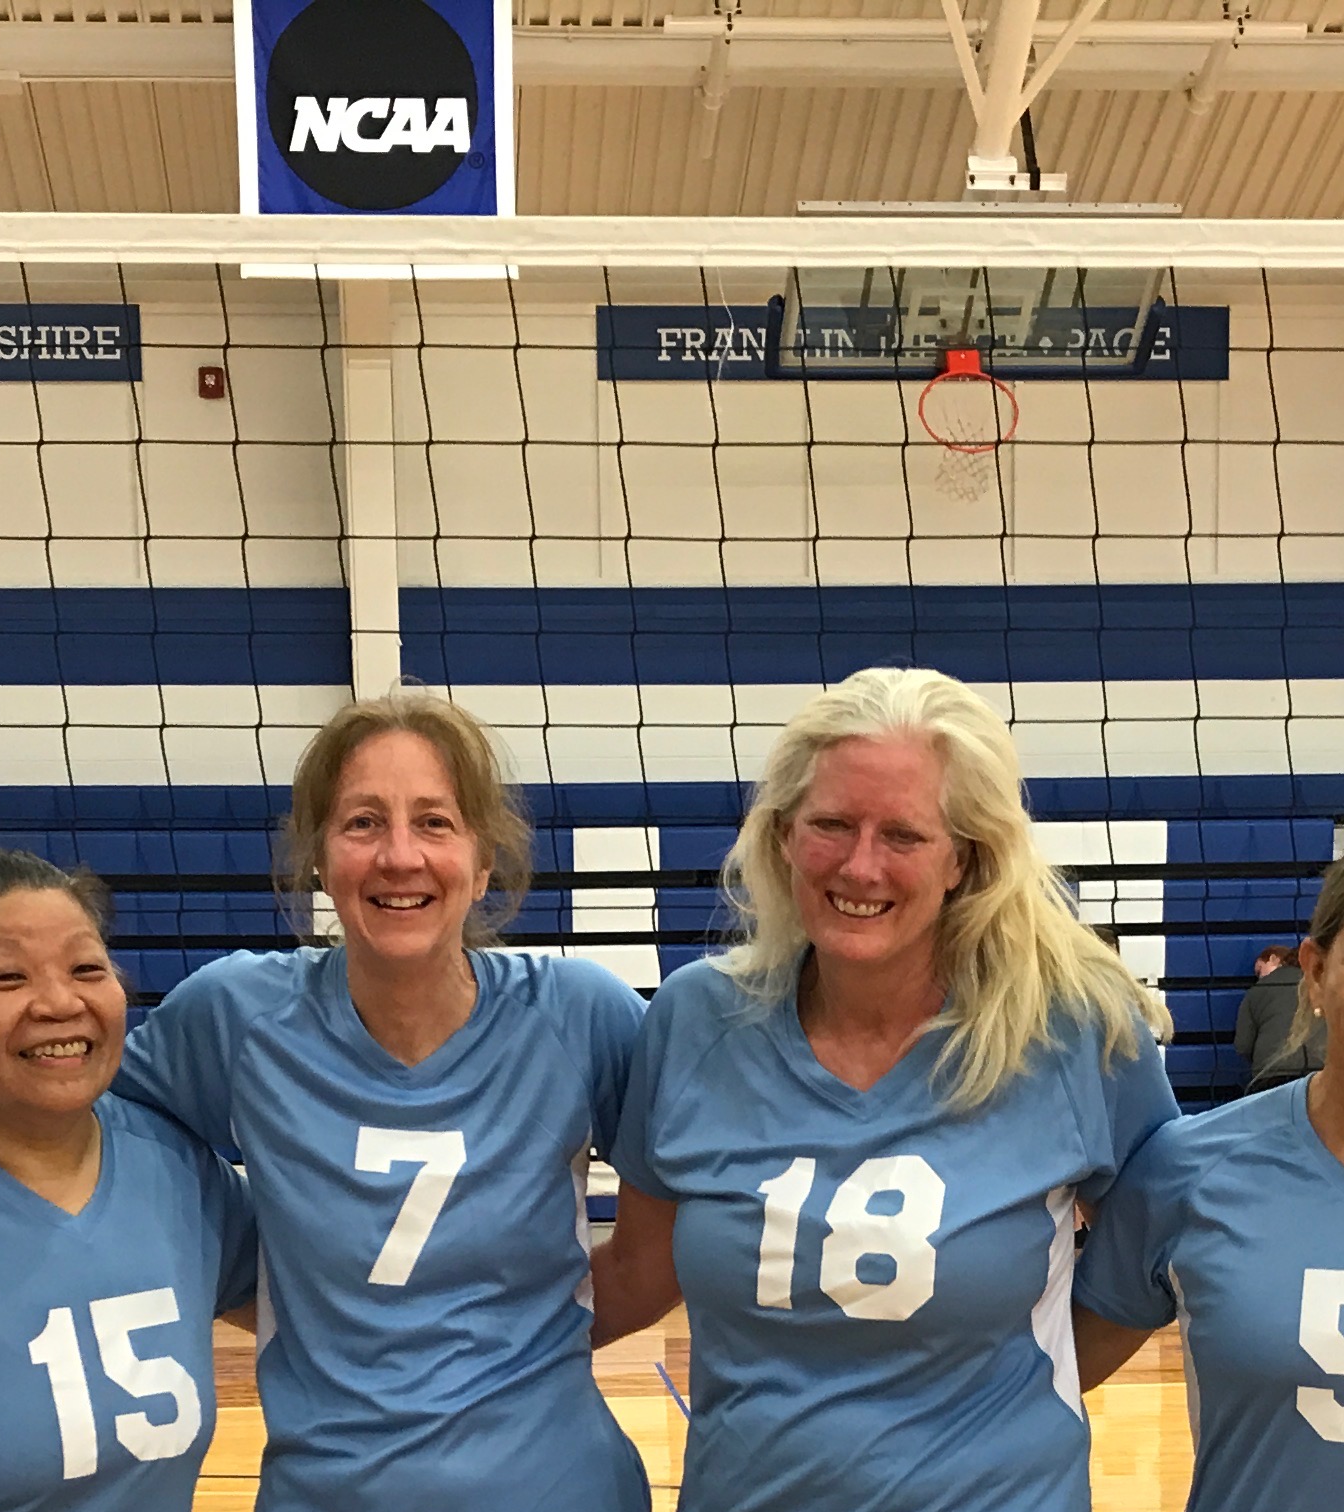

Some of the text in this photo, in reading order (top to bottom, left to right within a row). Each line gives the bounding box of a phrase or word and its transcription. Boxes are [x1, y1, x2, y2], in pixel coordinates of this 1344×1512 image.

[290, 97, 470, 152] NCAA
[657, 327, 860, 361] FRANLIN
[355, 1126, 467, 1286] 7
[757, 1155, 946, 1321] 18
[29, 1287, 202, 1481] 15
